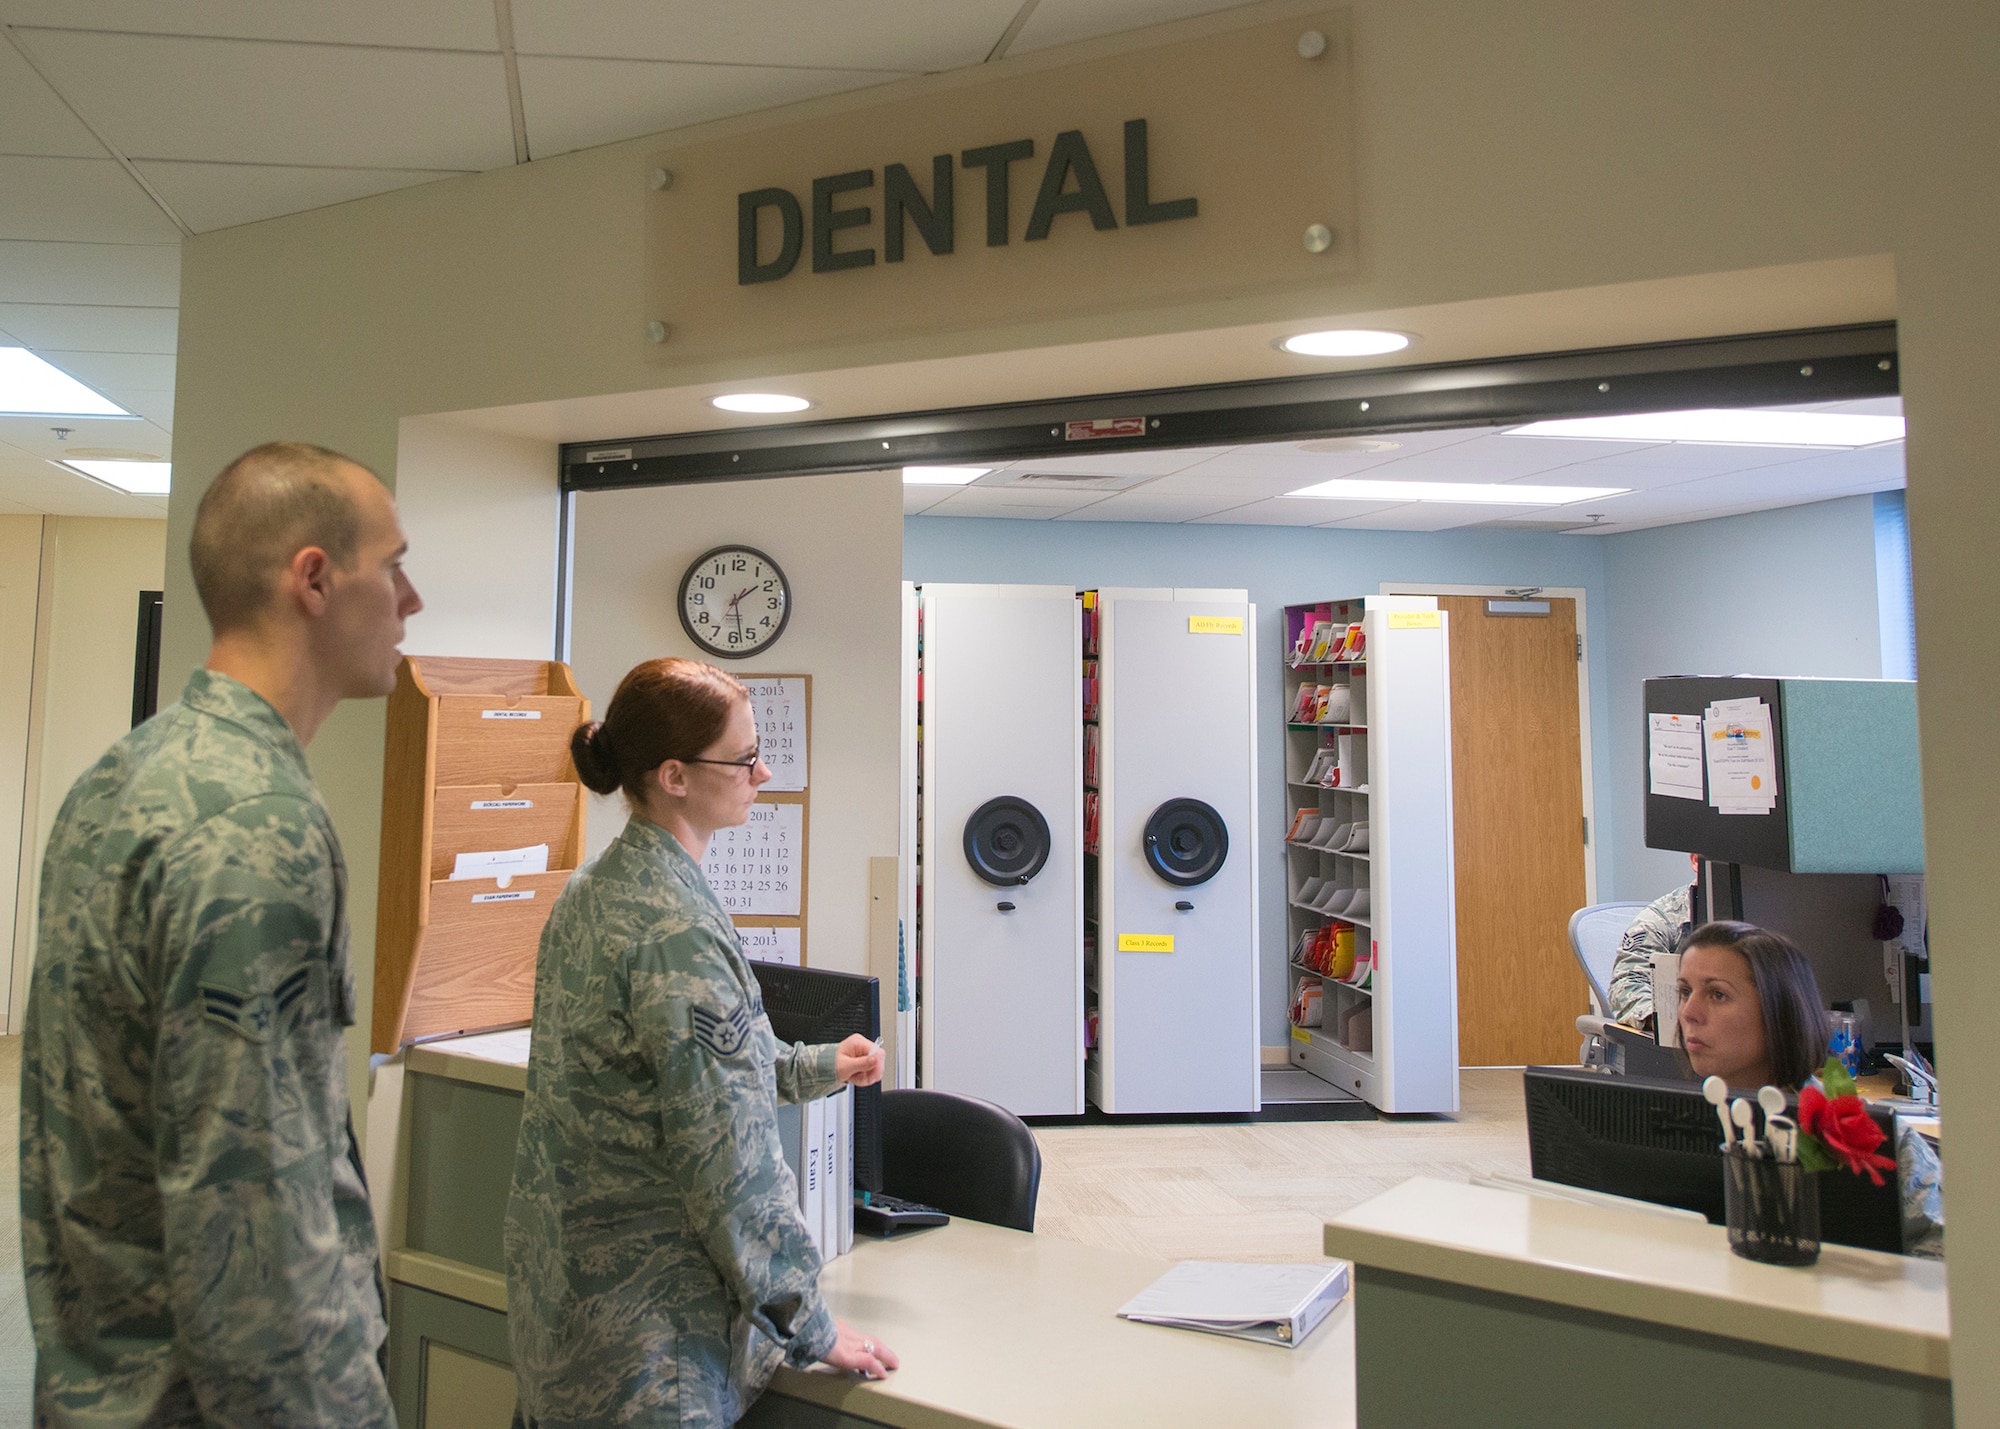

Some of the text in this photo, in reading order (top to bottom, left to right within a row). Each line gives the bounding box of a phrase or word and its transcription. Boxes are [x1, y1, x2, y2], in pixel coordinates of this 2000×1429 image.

[738, 118, 1198, 285] DENTAL
[715, 564, 726, 575] 11
[732, 560, 746, 572] 12
[755, 566, 759, 578] 1
[700, 577, 715, 589] 10
[763, 580, 774, 592] 2
[694, 593, 704, 605] 9
[767, 598, 778, 609] 3
[699, 612, 709, 624] 8
[760, 616, 770, 628] 4
[712, 626, 721, 637] 7
[746, 628, 756, 640] 5
[728, 632, 739, 644] 6
[760, 686, 785, 696] 2013
[766, 706, 773, 716] 6
[784, 706, 790, 716] 7
[765, 722, 776, 732] 13
[782, 722, 793, 732] 14
[764, 738, 792, 748] 20 21
[765, 754, 794, 764] 27 28
[750, 811, 774, 821] 2013
[712, 831, 786, 842] 1 2 3 4 5
[711, 847, 788, 858] 8 9 10 11 12
[708, 864, 788, 874] 15 16 17 18 19
[724, 880, 736, 891] 23
[741, 880, 753, 891] 24
[758, 881, 770, 891] 25
[775, 881, 788, 891] 26
[723, 897, 752, 907] 30 31
[753, 936, 778, 946] 2013
[810, 1148, 818, 1191] Exam
